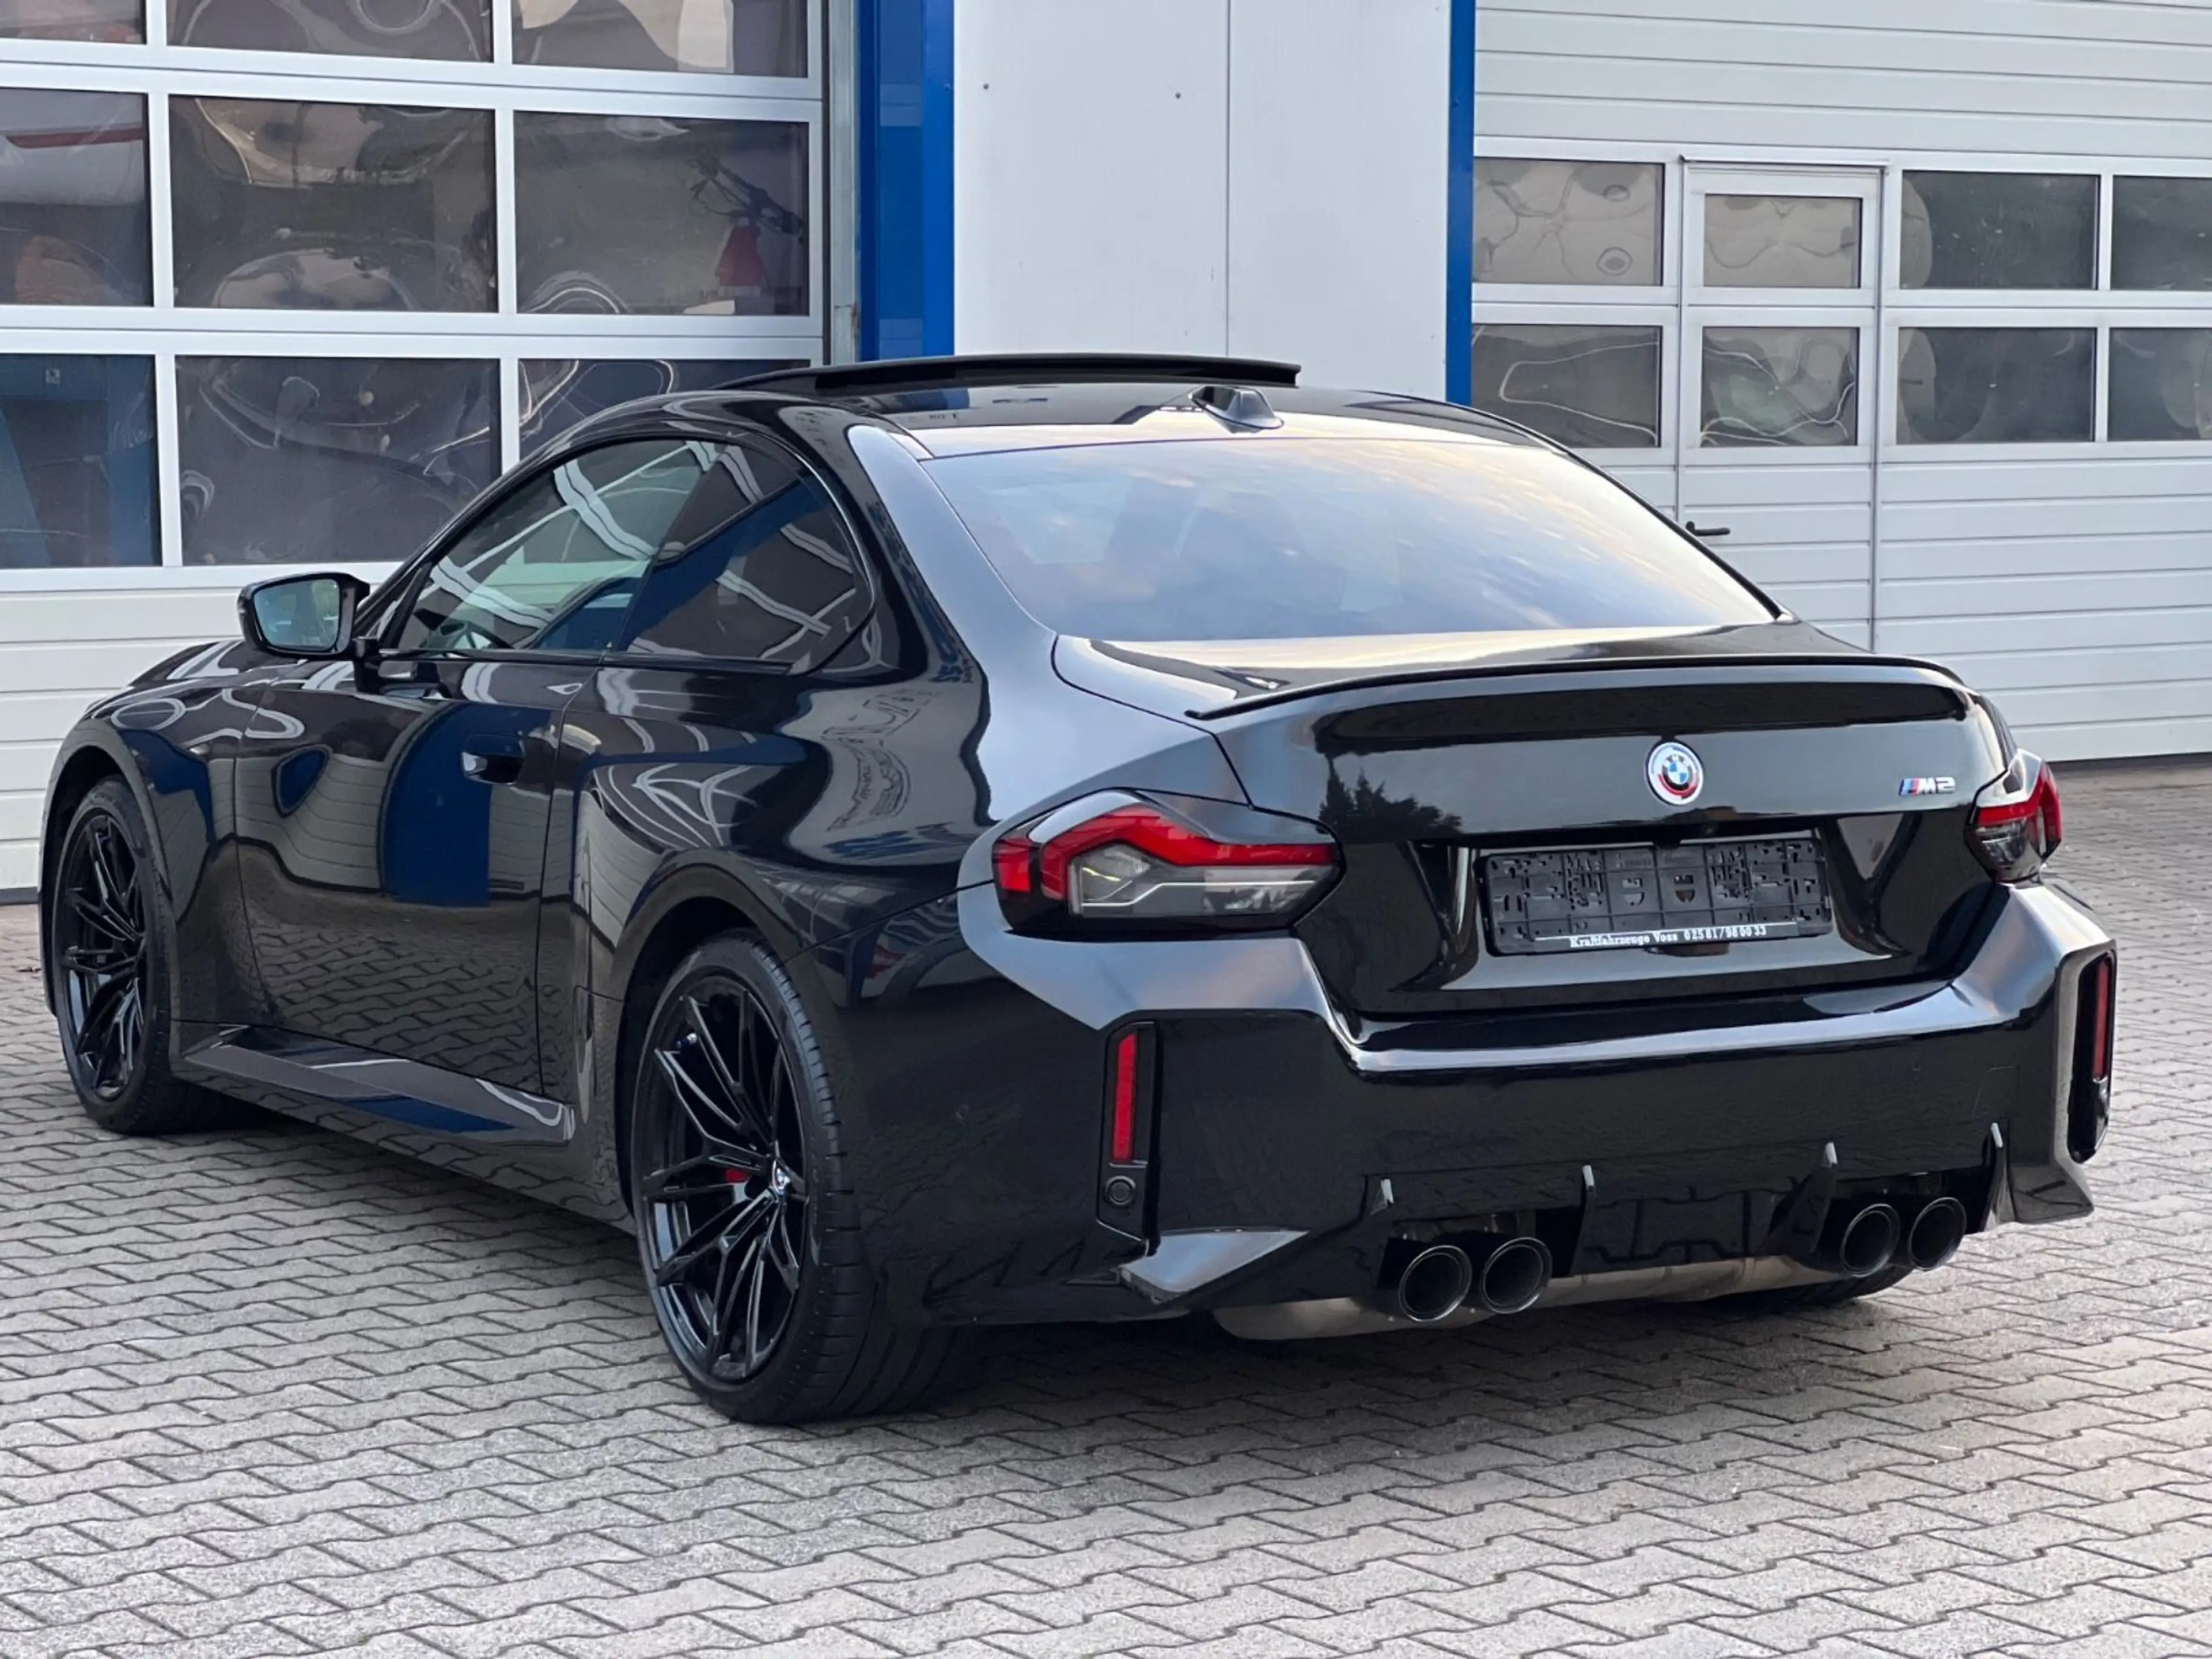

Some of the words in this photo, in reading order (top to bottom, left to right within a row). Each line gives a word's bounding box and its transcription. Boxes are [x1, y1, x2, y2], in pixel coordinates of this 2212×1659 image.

[1917, 777, 1956, 794] M2
[1570, 934, 1650, 948] Kraftfahrzeuge
[1652, 932, 1678, 942] Voss
